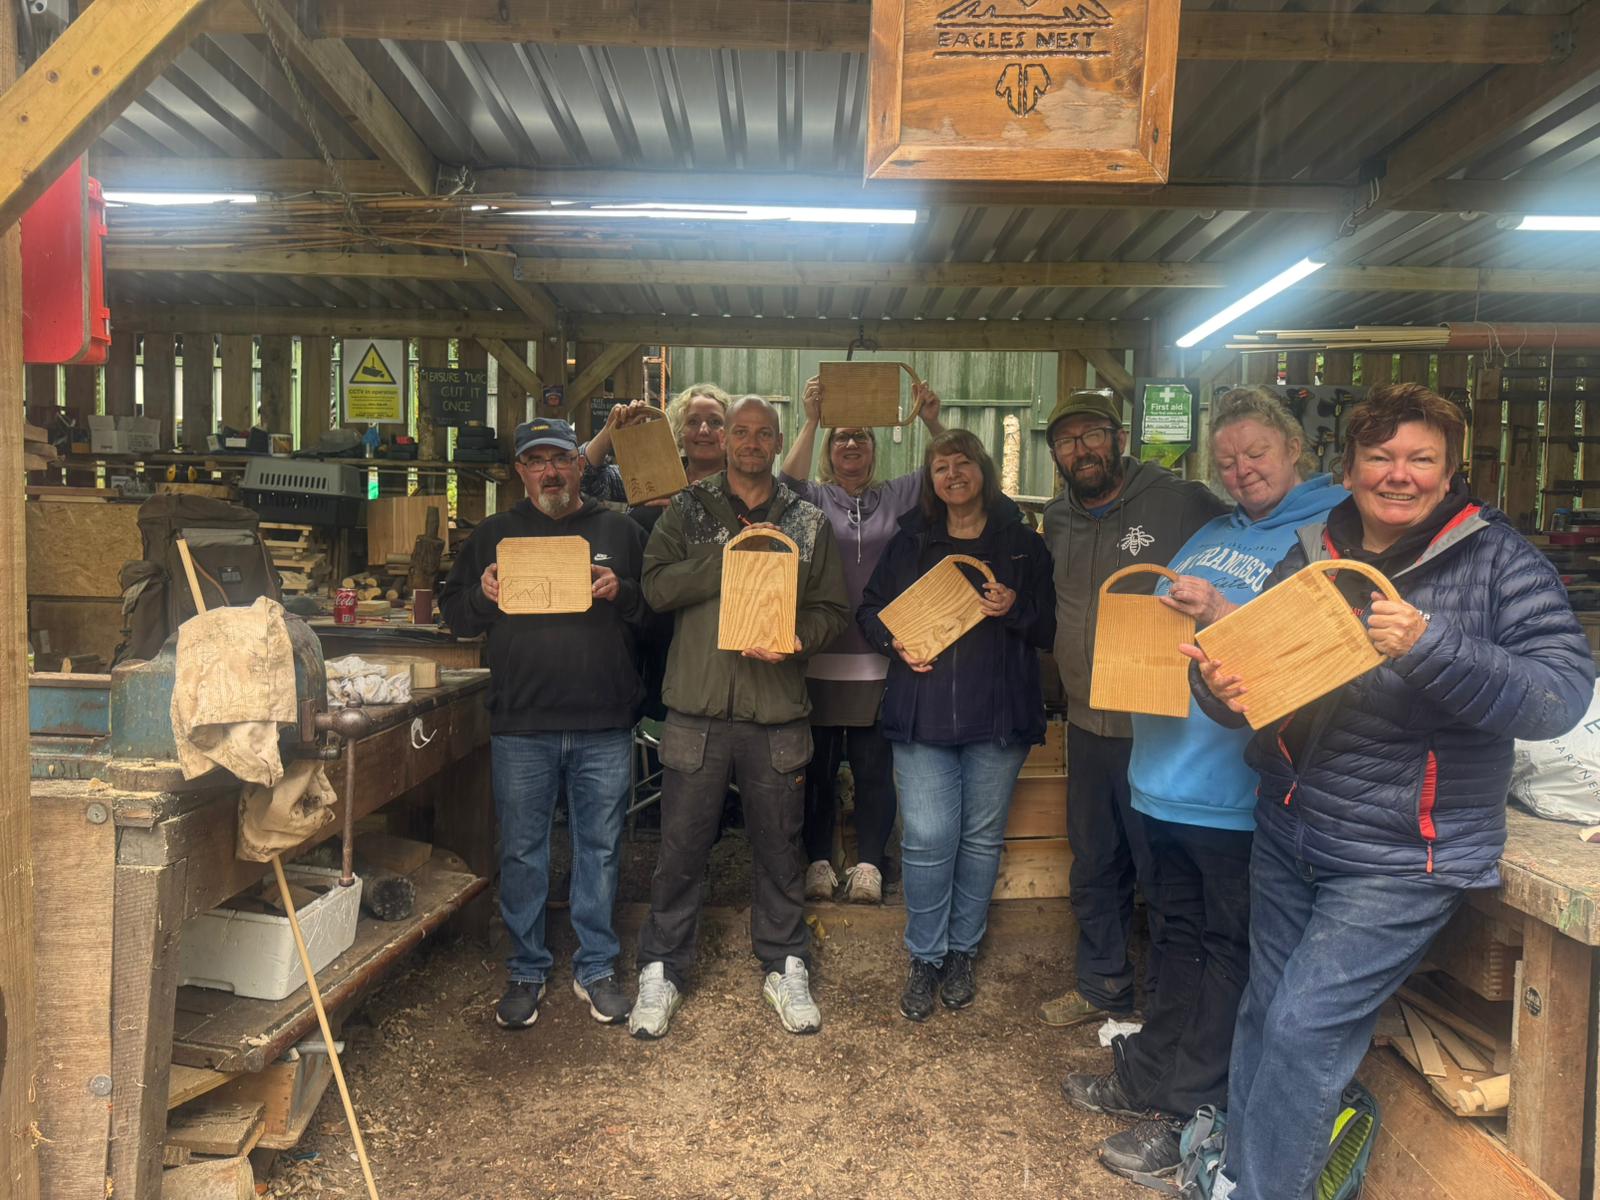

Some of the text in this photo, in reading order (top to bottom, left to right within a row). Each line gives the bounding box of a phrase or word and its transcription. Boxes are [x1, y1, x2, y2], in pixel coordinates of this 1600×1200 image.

[937, 31, 1096, 49] EAGLES NEST
[440, 385, 481, 400] CUT IT
[442, 400, 472, 412] ONCE
[1151, 403, 1183, 411] First aid
[1549, 739, 1600, 802] PARTNER
